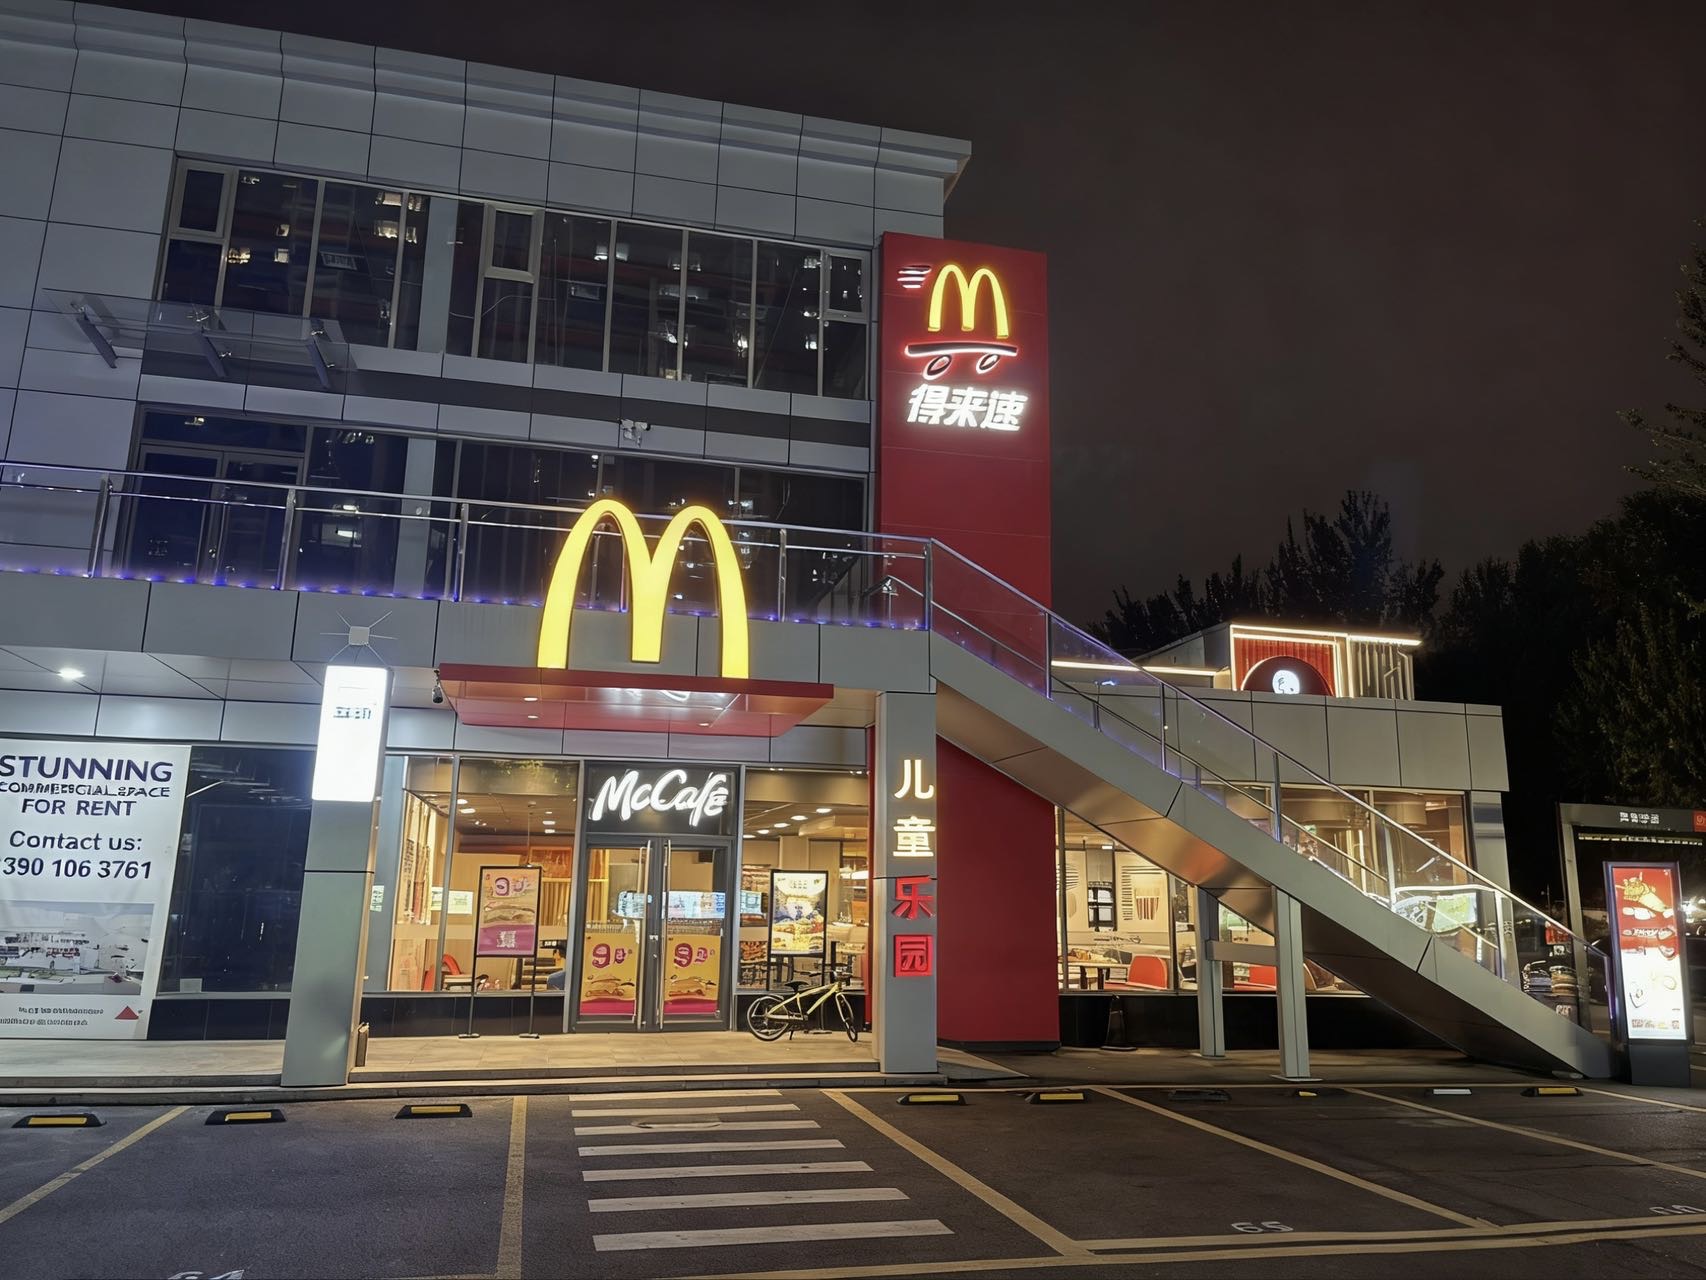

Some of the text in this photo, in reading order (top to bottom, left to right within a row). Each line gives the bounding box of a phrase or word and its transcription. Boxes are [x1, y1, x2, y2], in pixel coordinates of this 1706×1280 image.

[906, 384, 1028, 431] 得来速
[0, 755, 173, 782] STUNNING
[21, 798, 137, 816] FOR RENT
[9, 830, 142, 851] Contact us:
[0, 857, 152, 879] 390 106 3761
